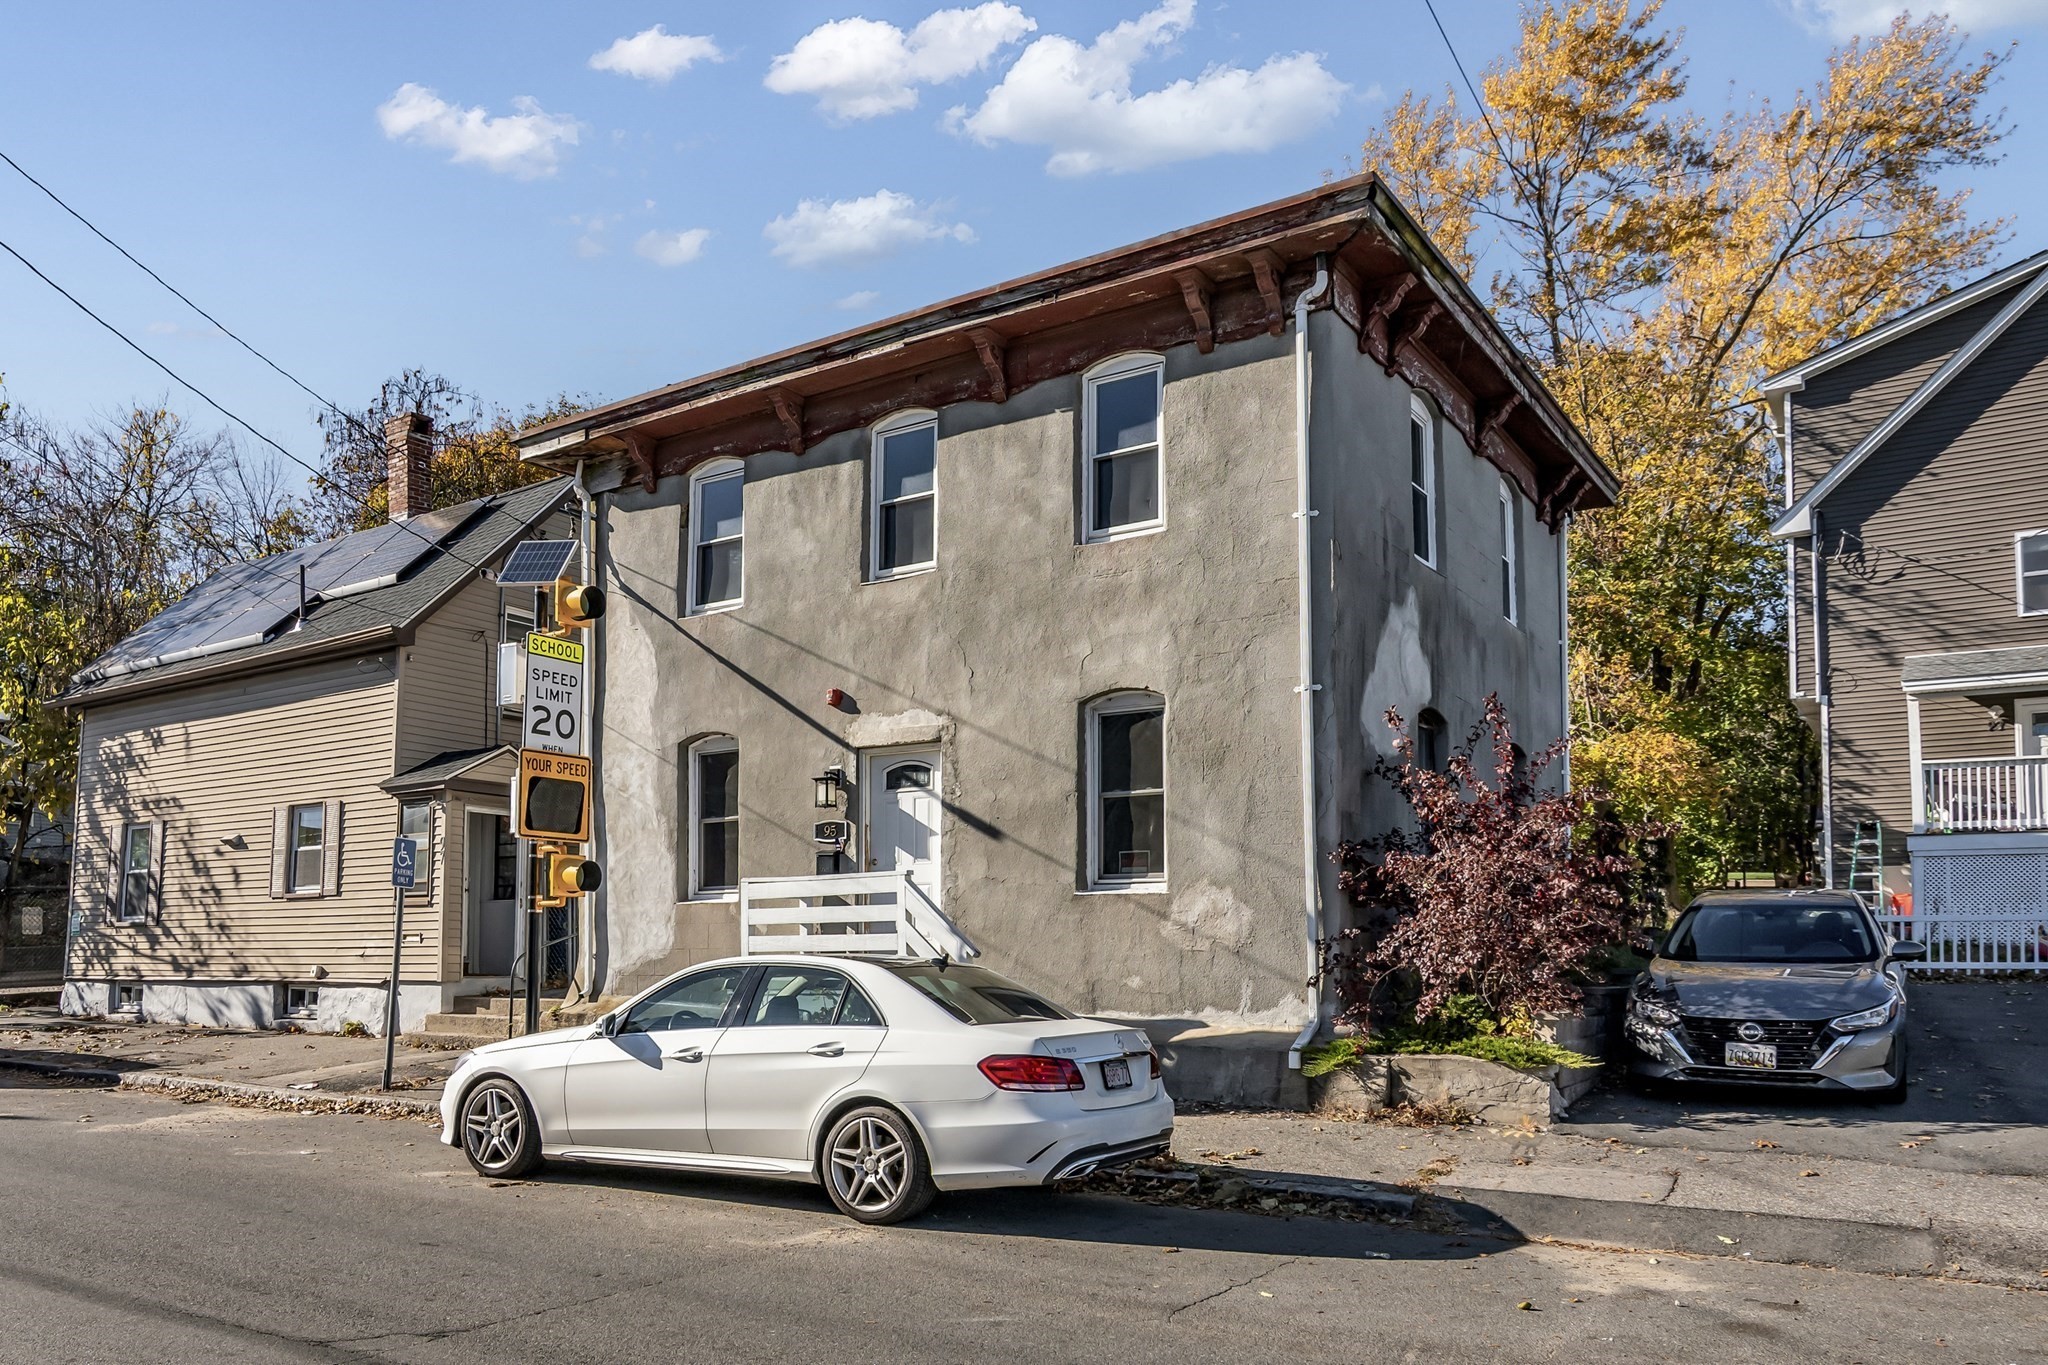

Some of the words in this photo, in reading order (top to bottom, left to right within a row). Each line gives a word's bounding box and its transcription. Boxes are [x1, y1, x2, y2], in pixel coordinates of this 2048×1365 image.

[532, 638, 580, 660] SCHOOL
[532, 668, 578, 688] SPEED
[536, 686, 573, 705] LIMIT
[531, 705, 576, 739] 20
[525, 757, 552, 773] YOUR
[556, 761, 587, 778] SPEED
[824, 825, 837, 837] 95
[394, 867, 414, 877] PARKING
[397, 876, 410, 884] ONLY
